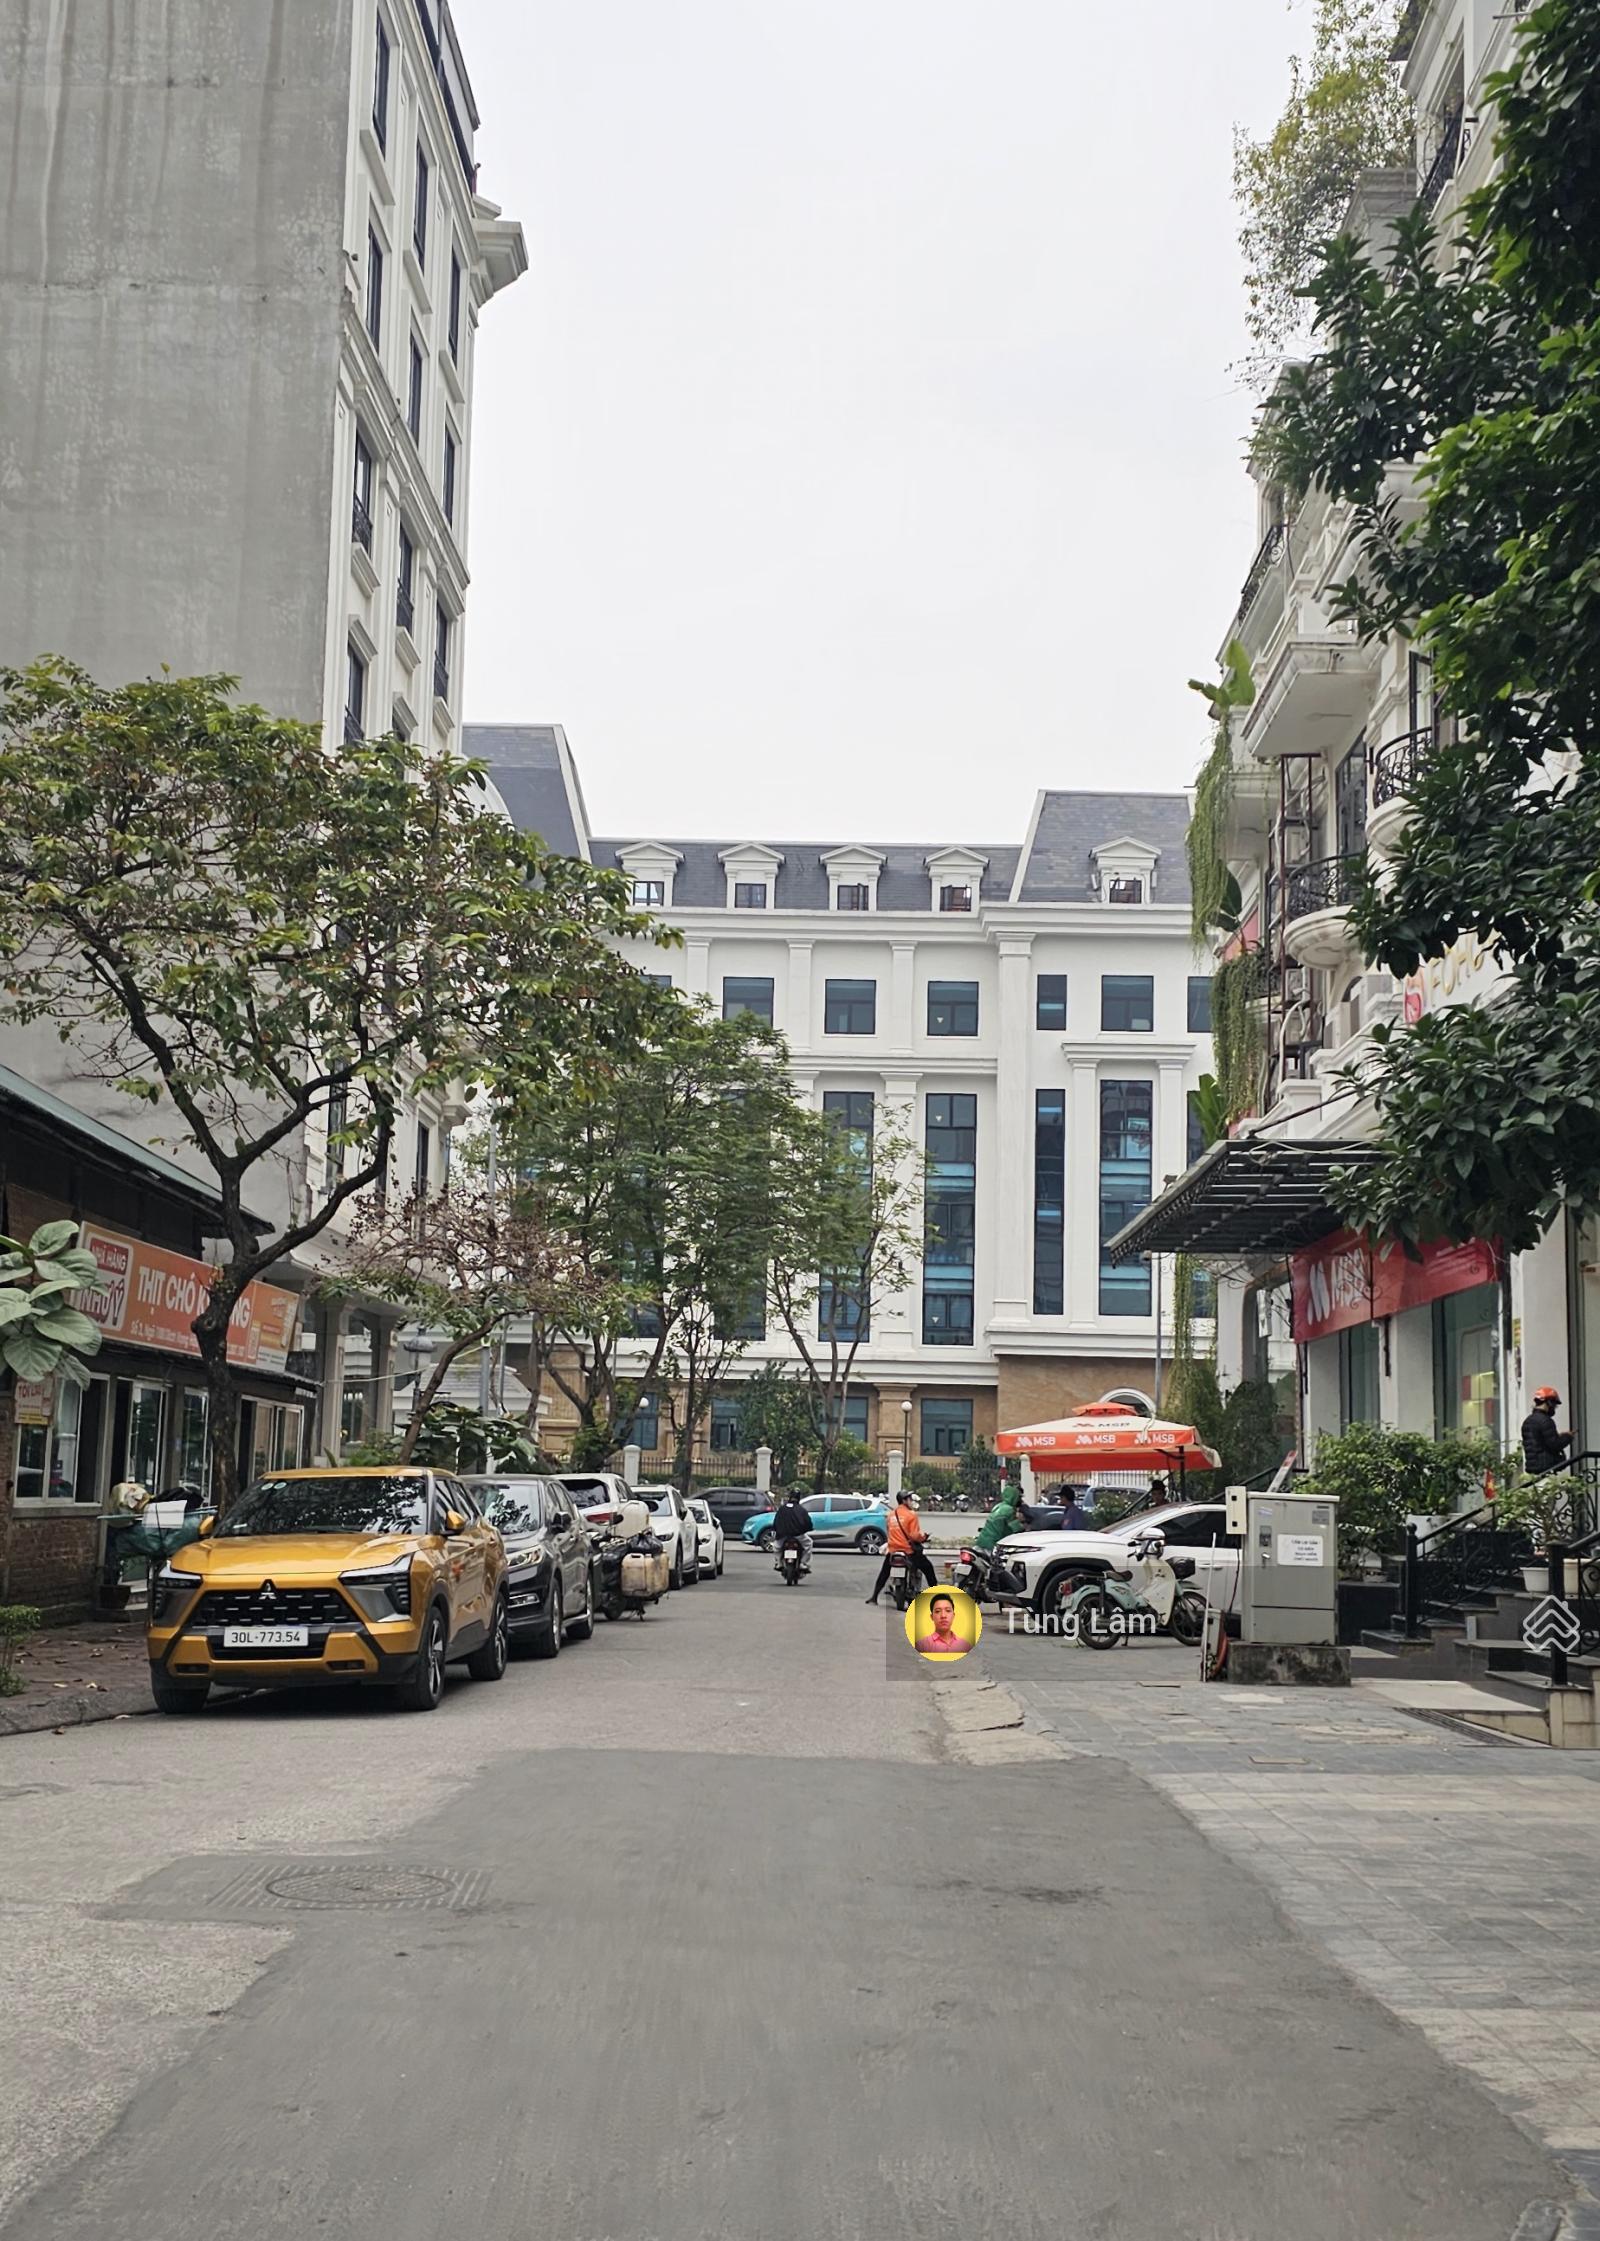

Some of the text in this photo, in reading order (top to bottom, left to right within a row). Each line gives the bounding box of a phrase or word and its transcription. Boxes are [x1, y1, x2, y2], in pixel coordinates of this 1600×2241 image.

[138, 1265, 166, 1315] THỊT
[165, 1272, 196, 1315] CHÓ
[1033, 1436, 1056, 1446] MSB
[1093, 1434, 1116, 1444] MSB
[1152, 1433, 1176, 1444] MSB
[231, 1631, 300, 1643] 30L-773.54
